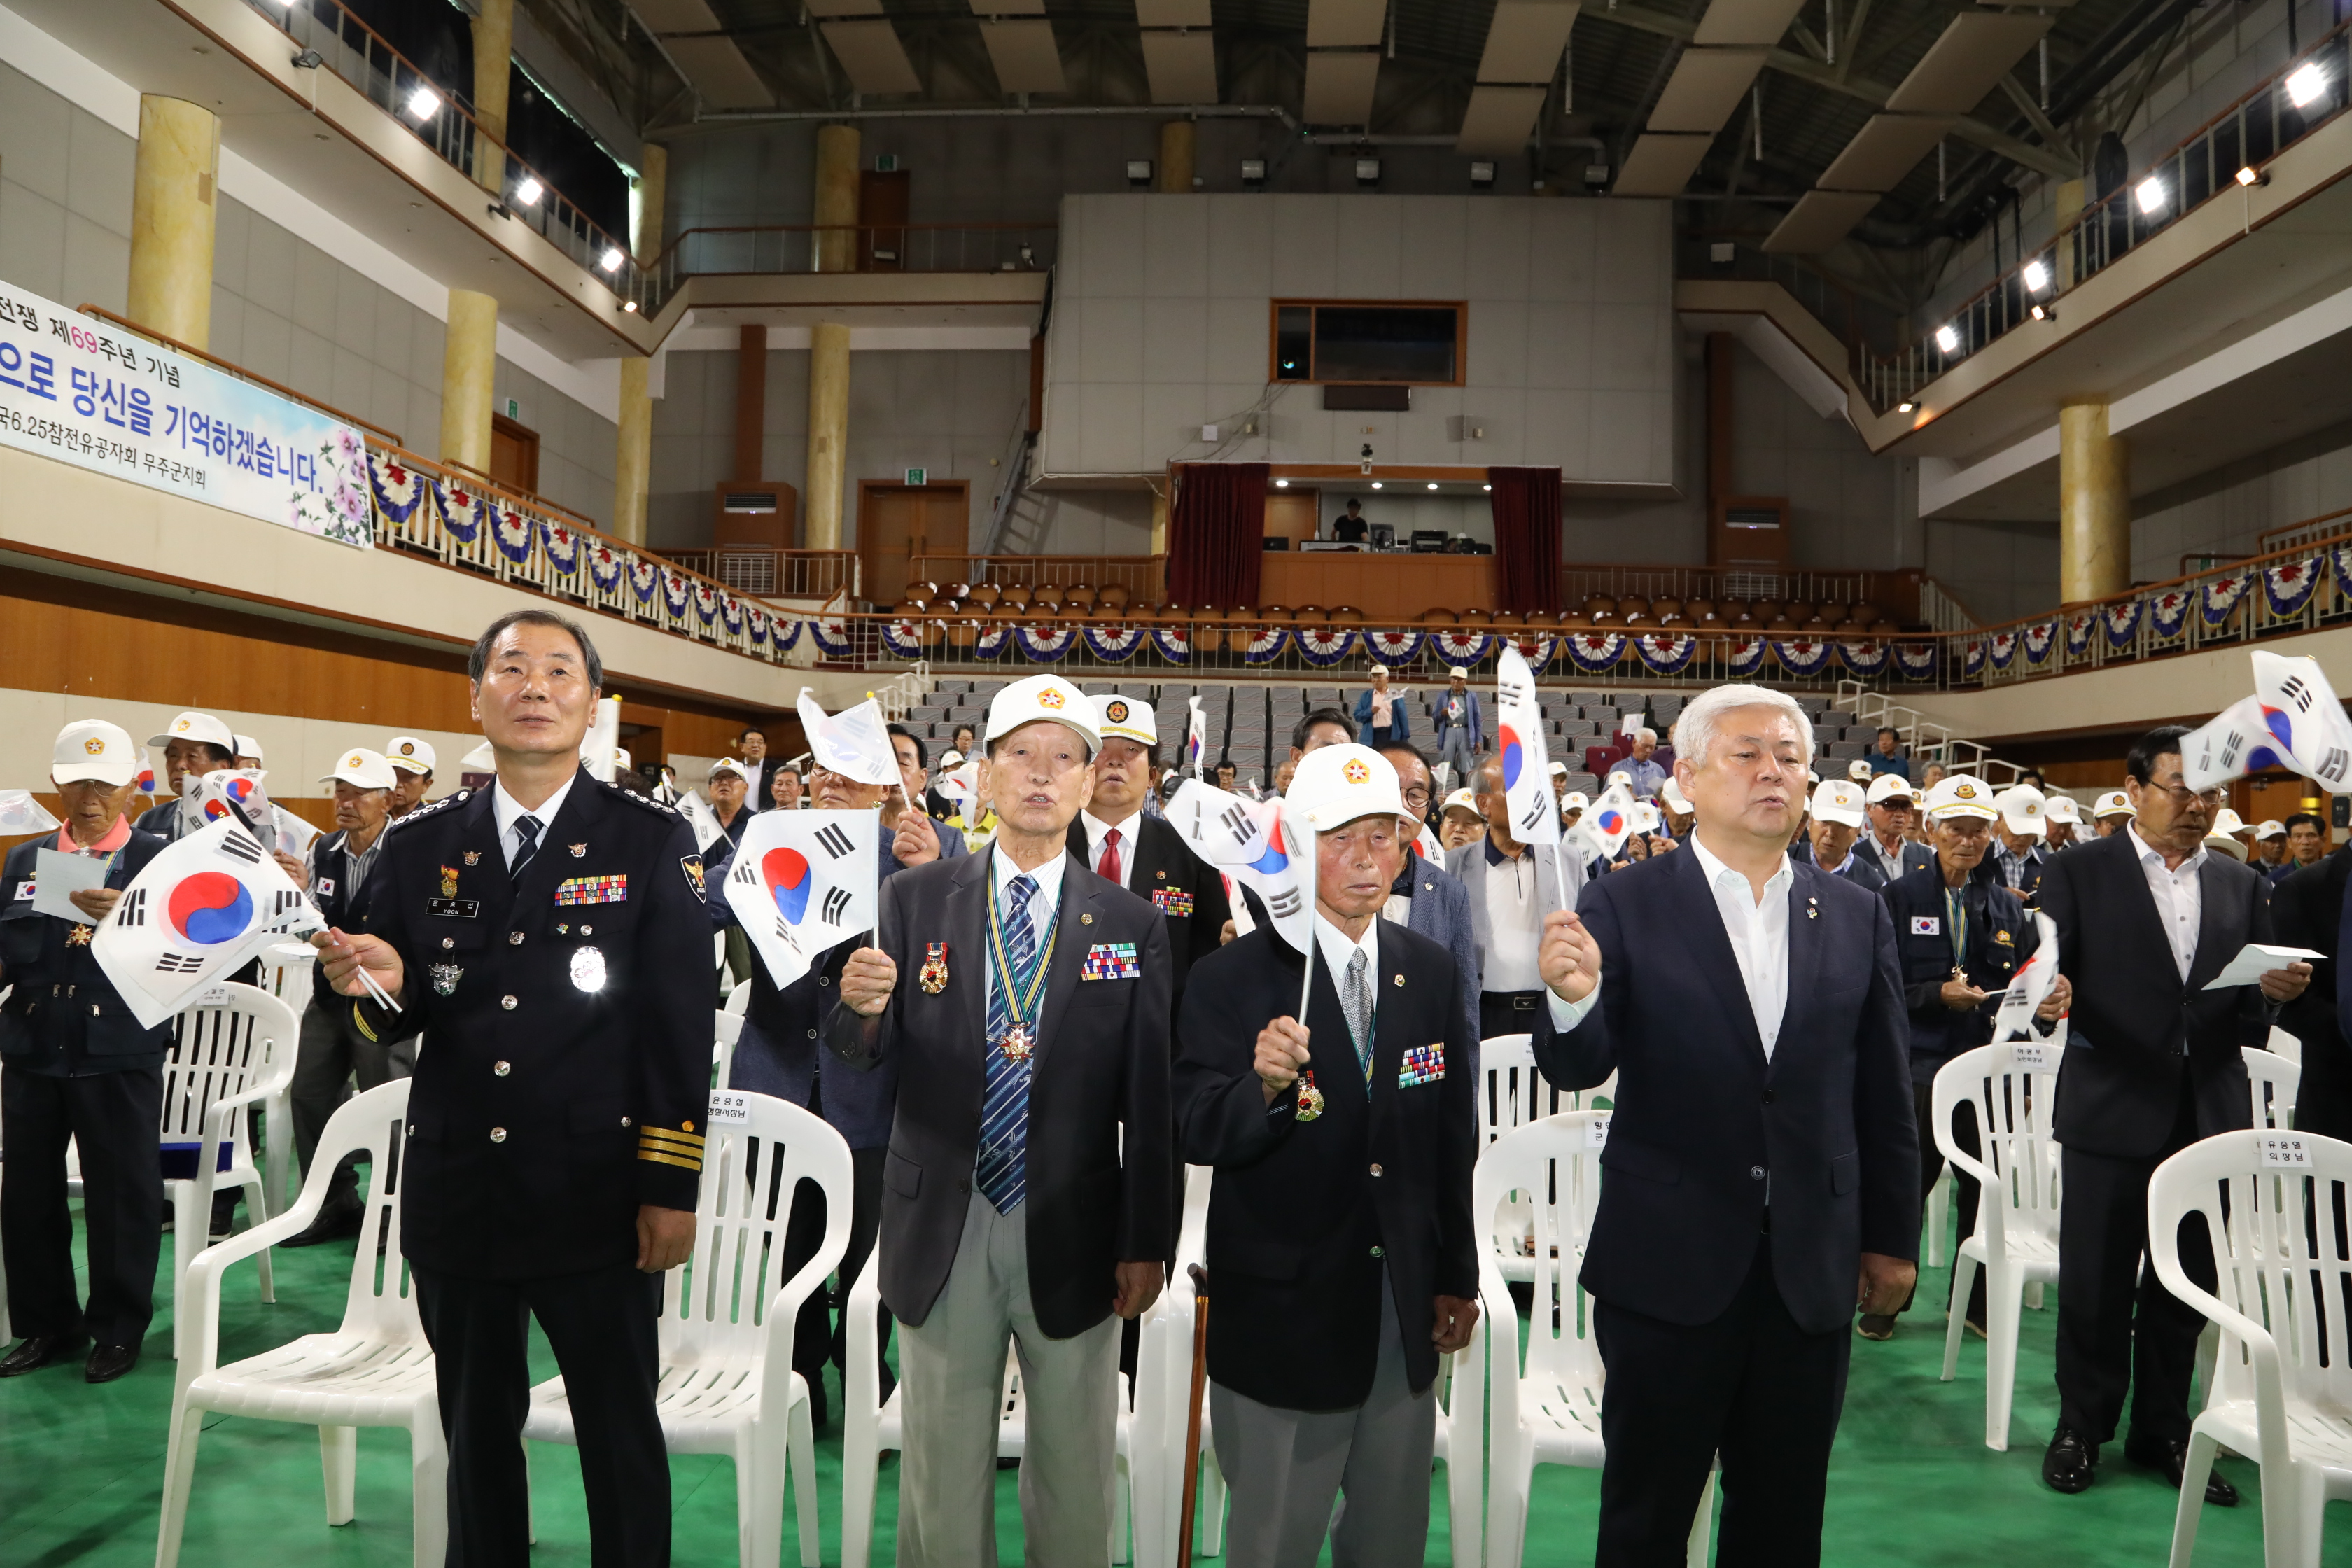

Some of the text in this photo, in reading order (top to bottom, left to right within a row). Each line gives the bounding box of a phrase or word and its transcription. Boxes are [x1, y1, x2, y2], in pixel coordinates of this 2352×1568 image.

[0, 296, 181, 388] 전쟁 제69주년 기념
[0, 342, 324, 494] 으로 당신을 기억하겠습니다.
[144, 454, 206, 489] 무주군지회
